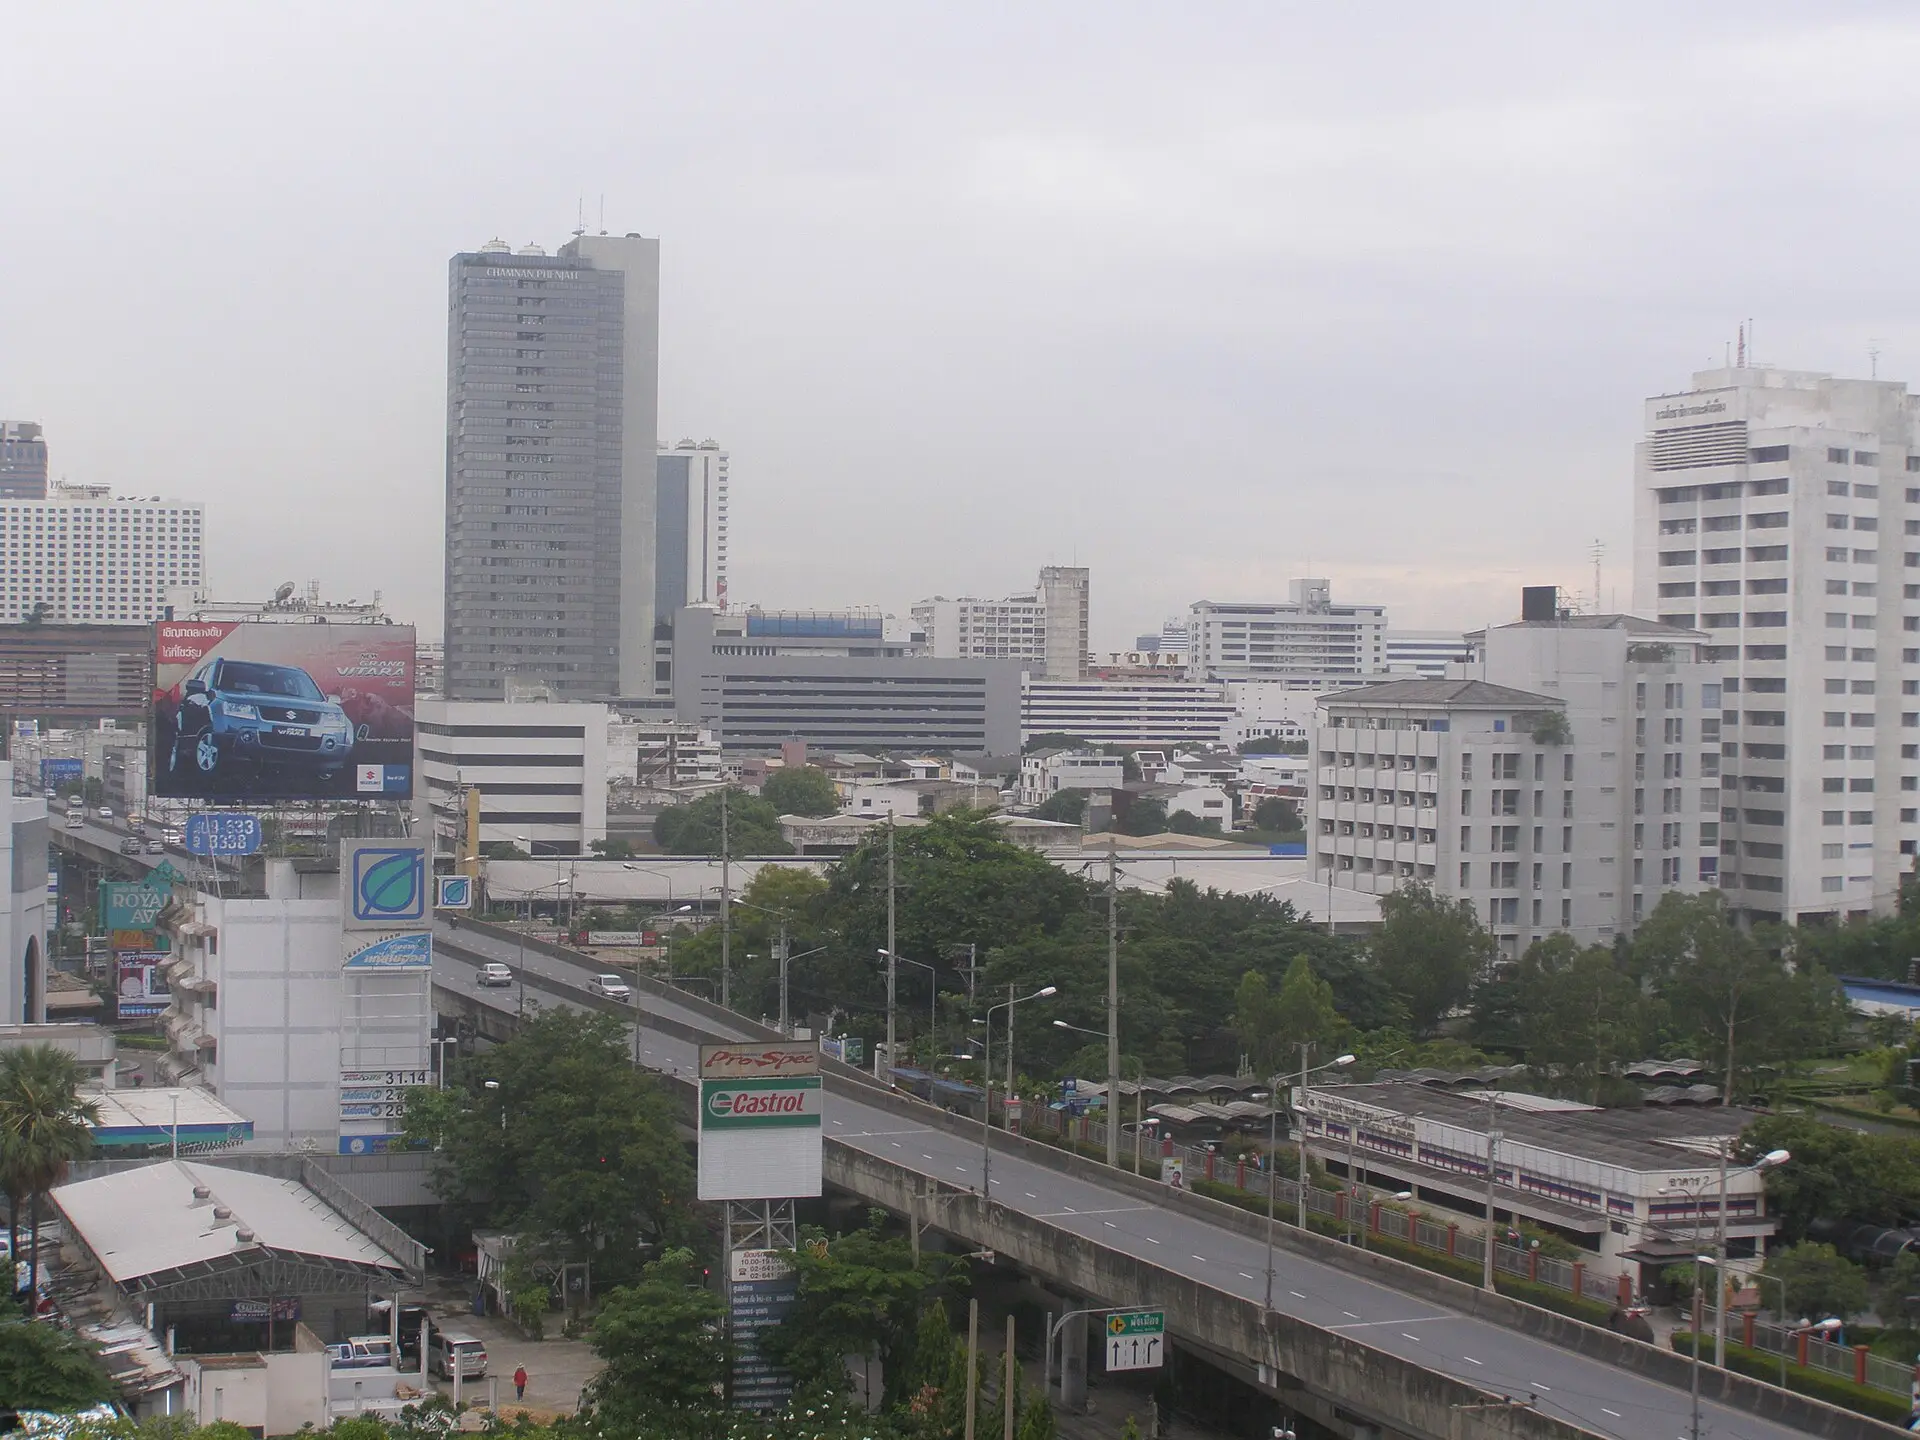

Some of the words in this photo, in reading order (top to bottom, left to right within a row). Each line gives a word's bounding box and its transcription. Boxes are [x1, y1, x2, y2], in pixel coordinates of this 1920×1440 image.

[487, 268, 533, 278] CHAMNAN
[1109, 652, 1179, 664] TOWN
[336, 666, 404, 677] VITARA
[705, 1051, 752, 1068] Pro
[755, 1051, 814, 1070] Spec
[386, 1072, 426, 1085] 31.14
[733, 1093, 805, 1114] Castrol
[386, 1105, 403, 1117] 28
[1703, 1175, 1709, 1185] 2
